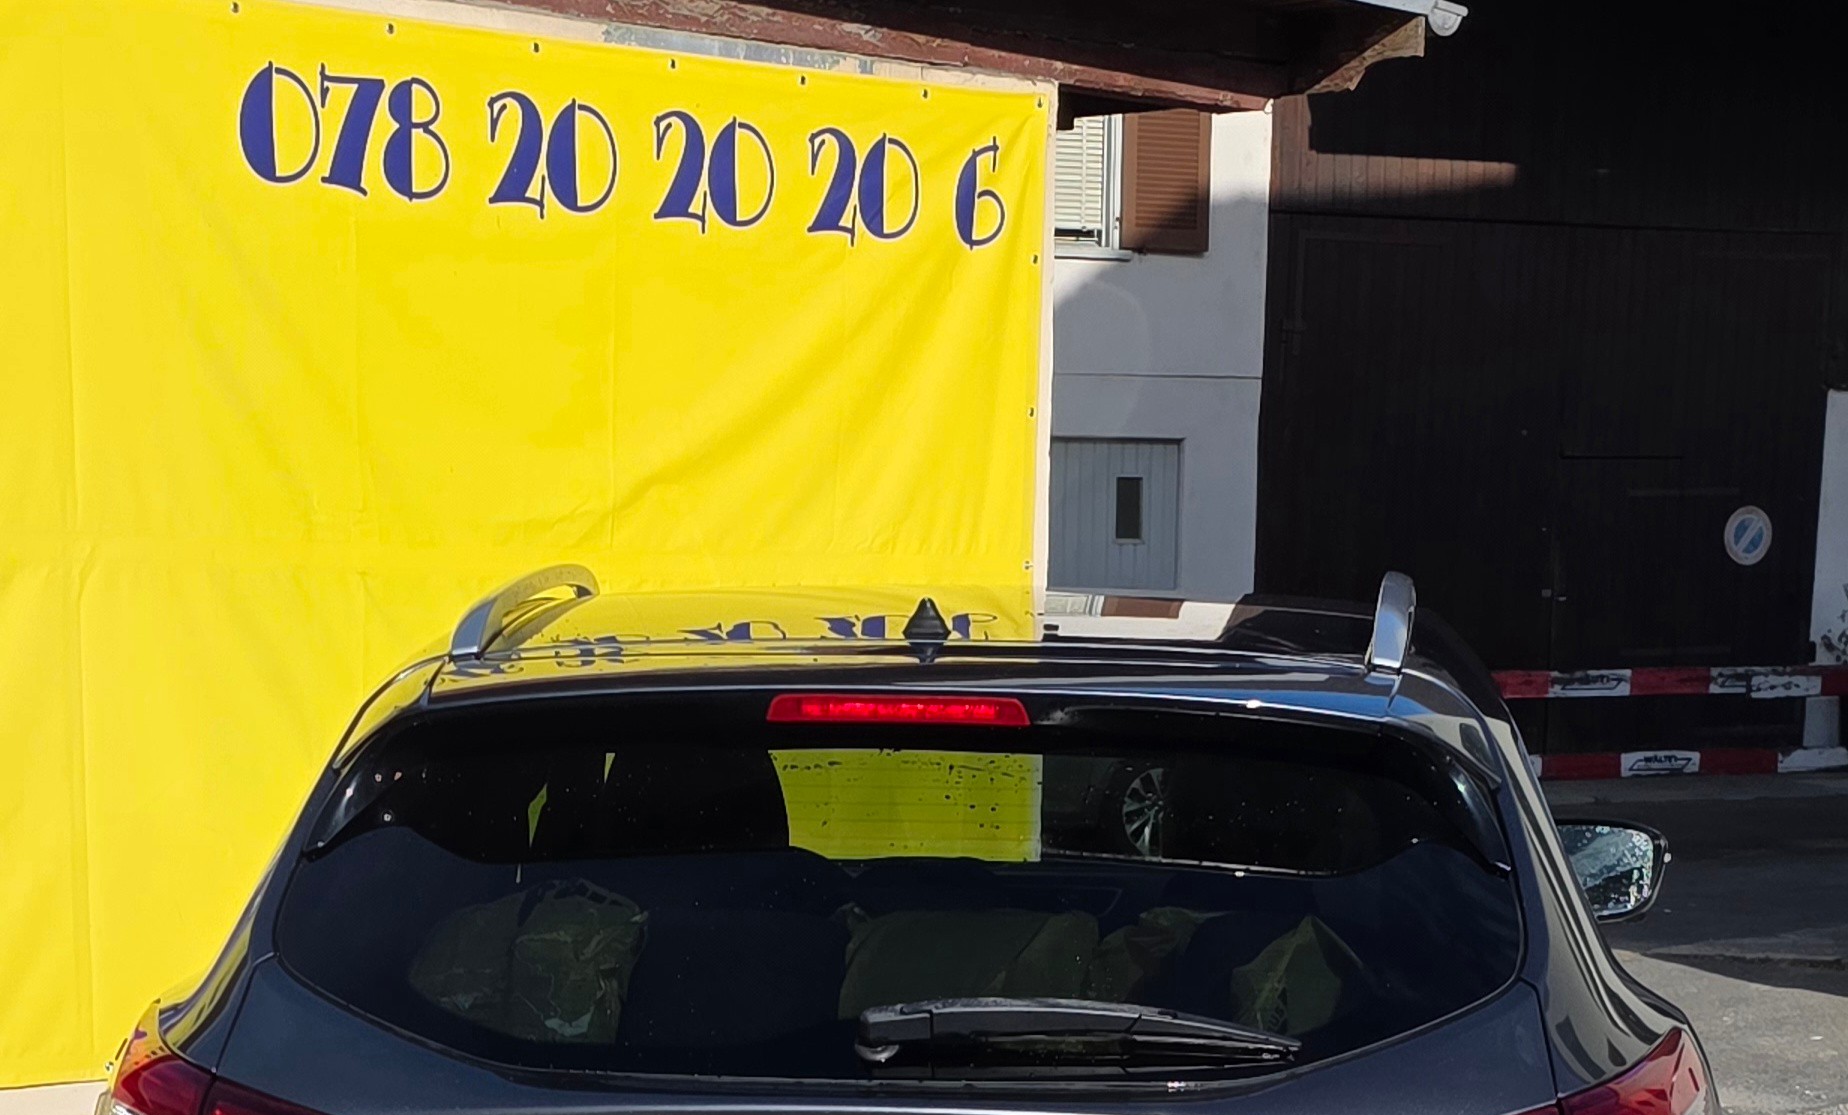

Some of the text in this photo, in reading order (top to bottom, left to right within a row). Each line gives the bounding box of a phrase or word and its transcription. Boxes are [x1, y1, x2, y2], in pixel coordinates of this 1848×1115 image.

[239, 60, 1006, 251] 078 20 20 20 6
